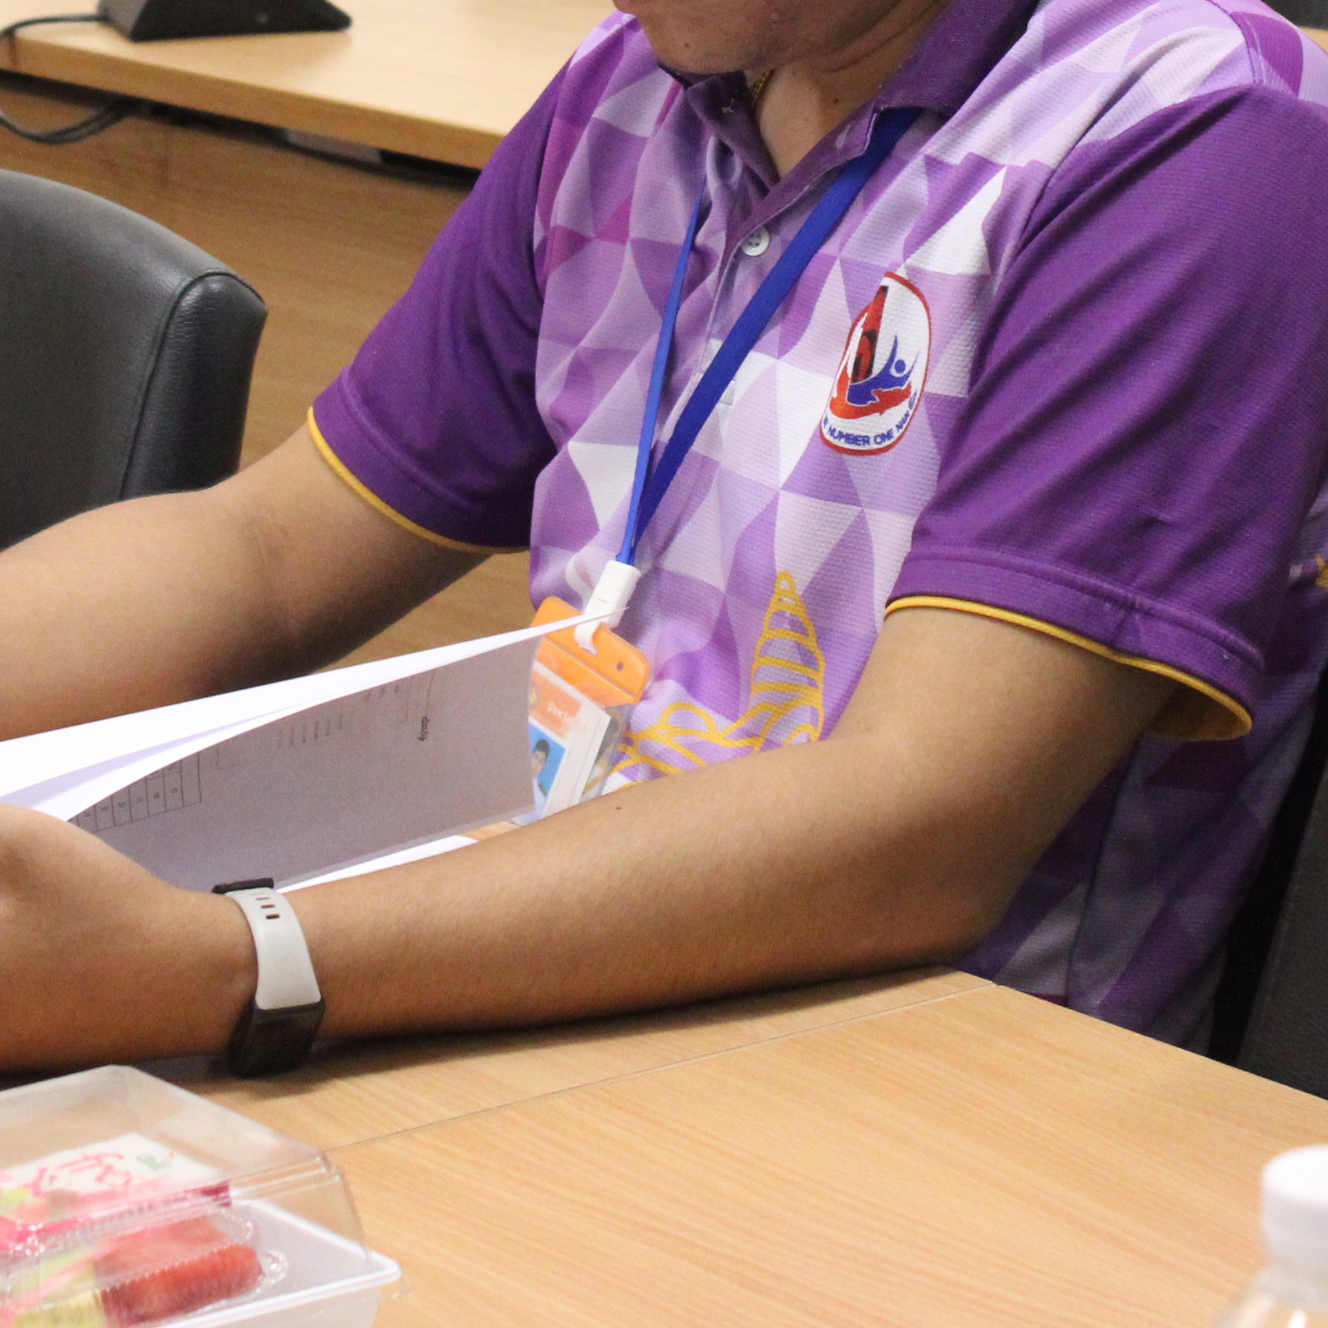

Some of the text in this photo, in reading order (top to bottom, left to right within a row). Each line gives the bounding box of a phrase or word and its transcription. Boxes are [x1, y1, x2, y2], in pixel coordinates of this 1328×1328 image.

[828, 410, 910, 446] NUMBER ONE NAN
